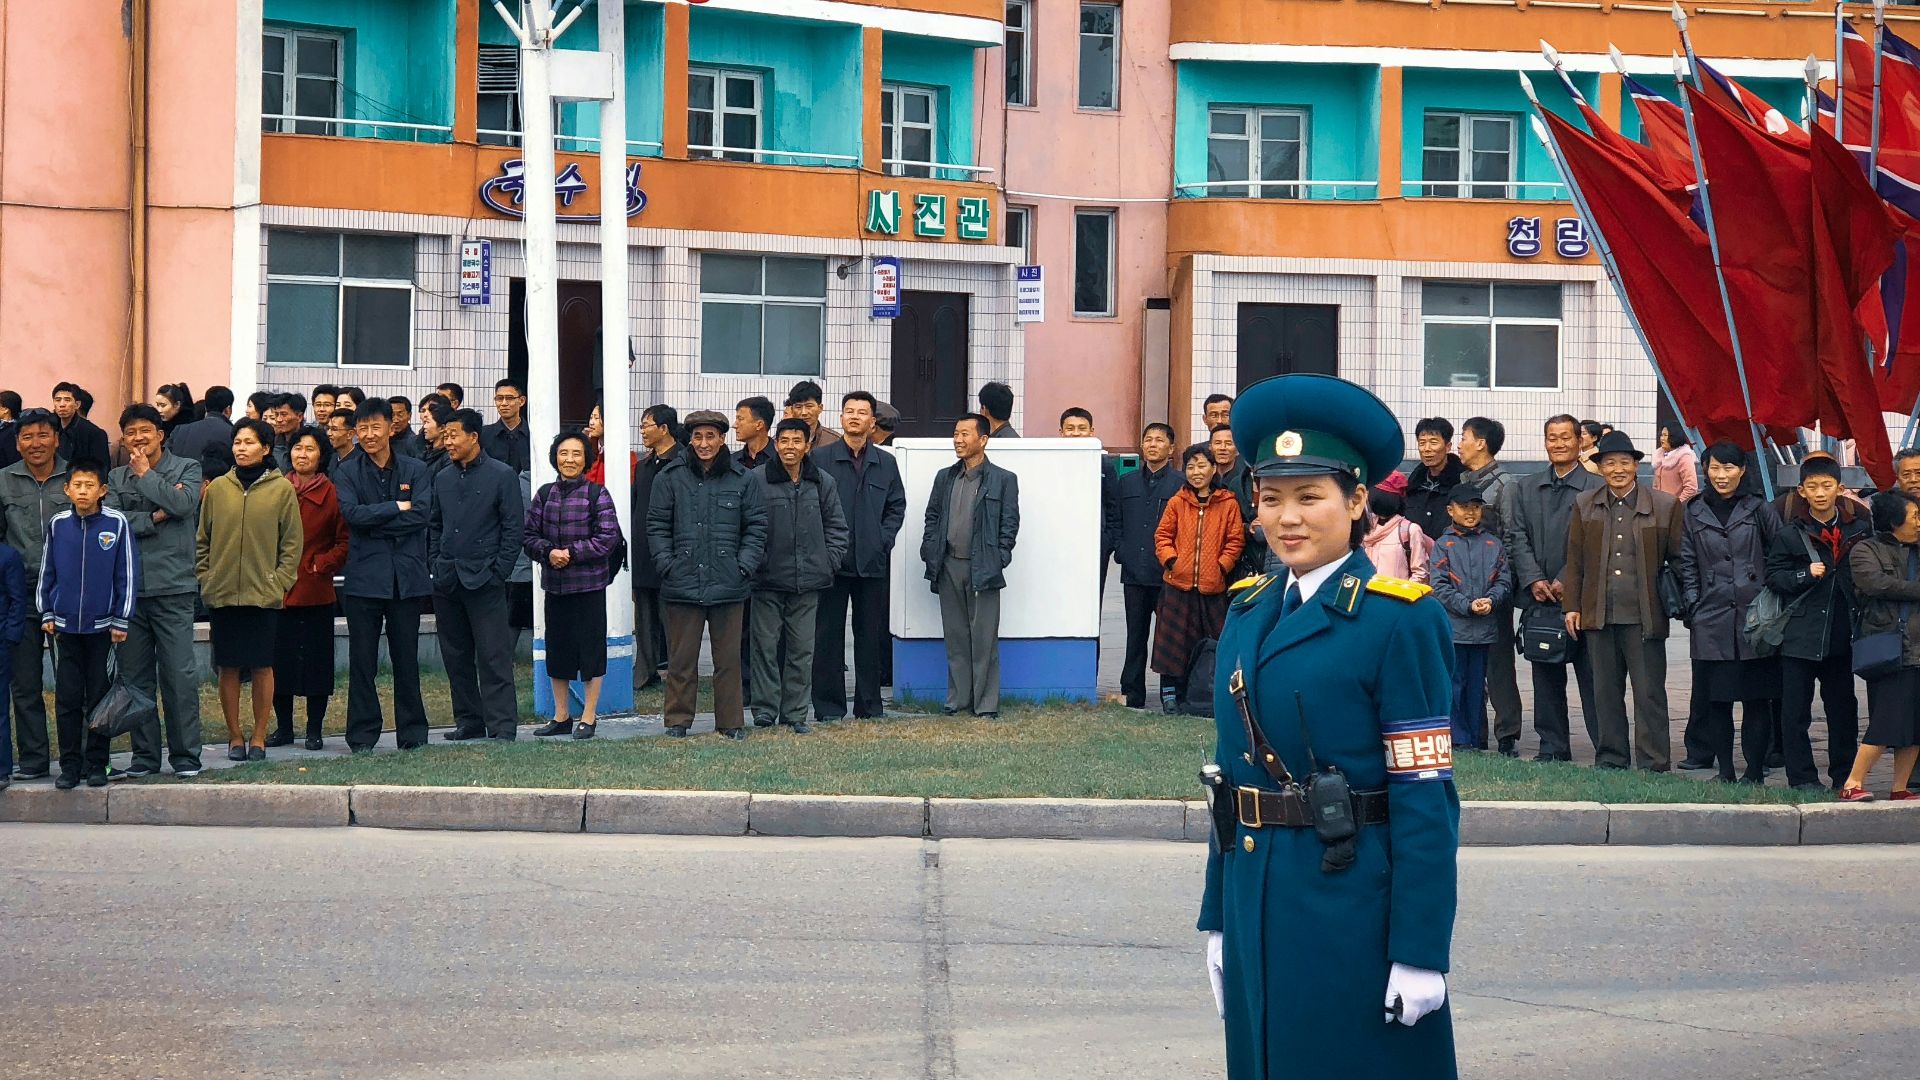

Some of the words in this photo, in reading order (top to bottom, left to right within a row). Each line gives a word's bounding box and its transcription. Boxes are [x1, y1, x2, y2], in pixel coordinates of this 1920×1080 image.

[865, 190, 991, 240] 사진관
[1021, 268, 1038, 278] 사진
[1383, 734, 1453, 769] 통보안
